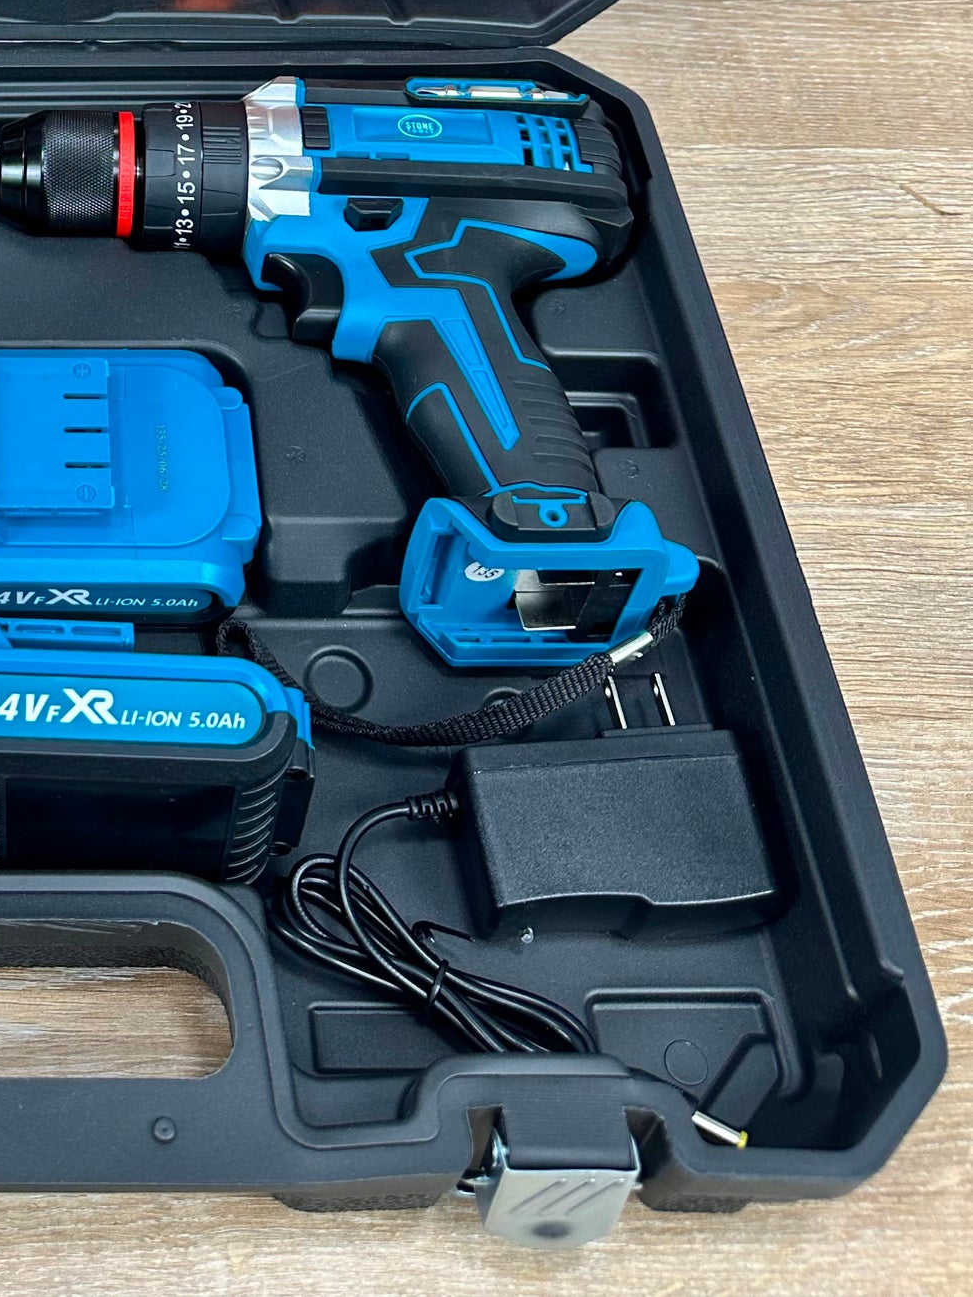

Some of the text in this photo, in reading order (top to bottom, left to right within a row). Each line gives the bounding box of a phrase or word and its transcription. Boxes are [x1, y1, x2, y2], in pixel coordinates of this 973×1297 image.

[175, 114, 194, 131] 19
[176, 143, 196, 165] 17
[176, 181, 196, 204] 15
[175, 218, 194, 235] 13
[95, 598, 146, 607] LI-ION
[150, 598, 199, 608] 5.0Ah
[120, 709, 182, 727] LI-ION
[188, 711, 246, 730] 5.0Ah
